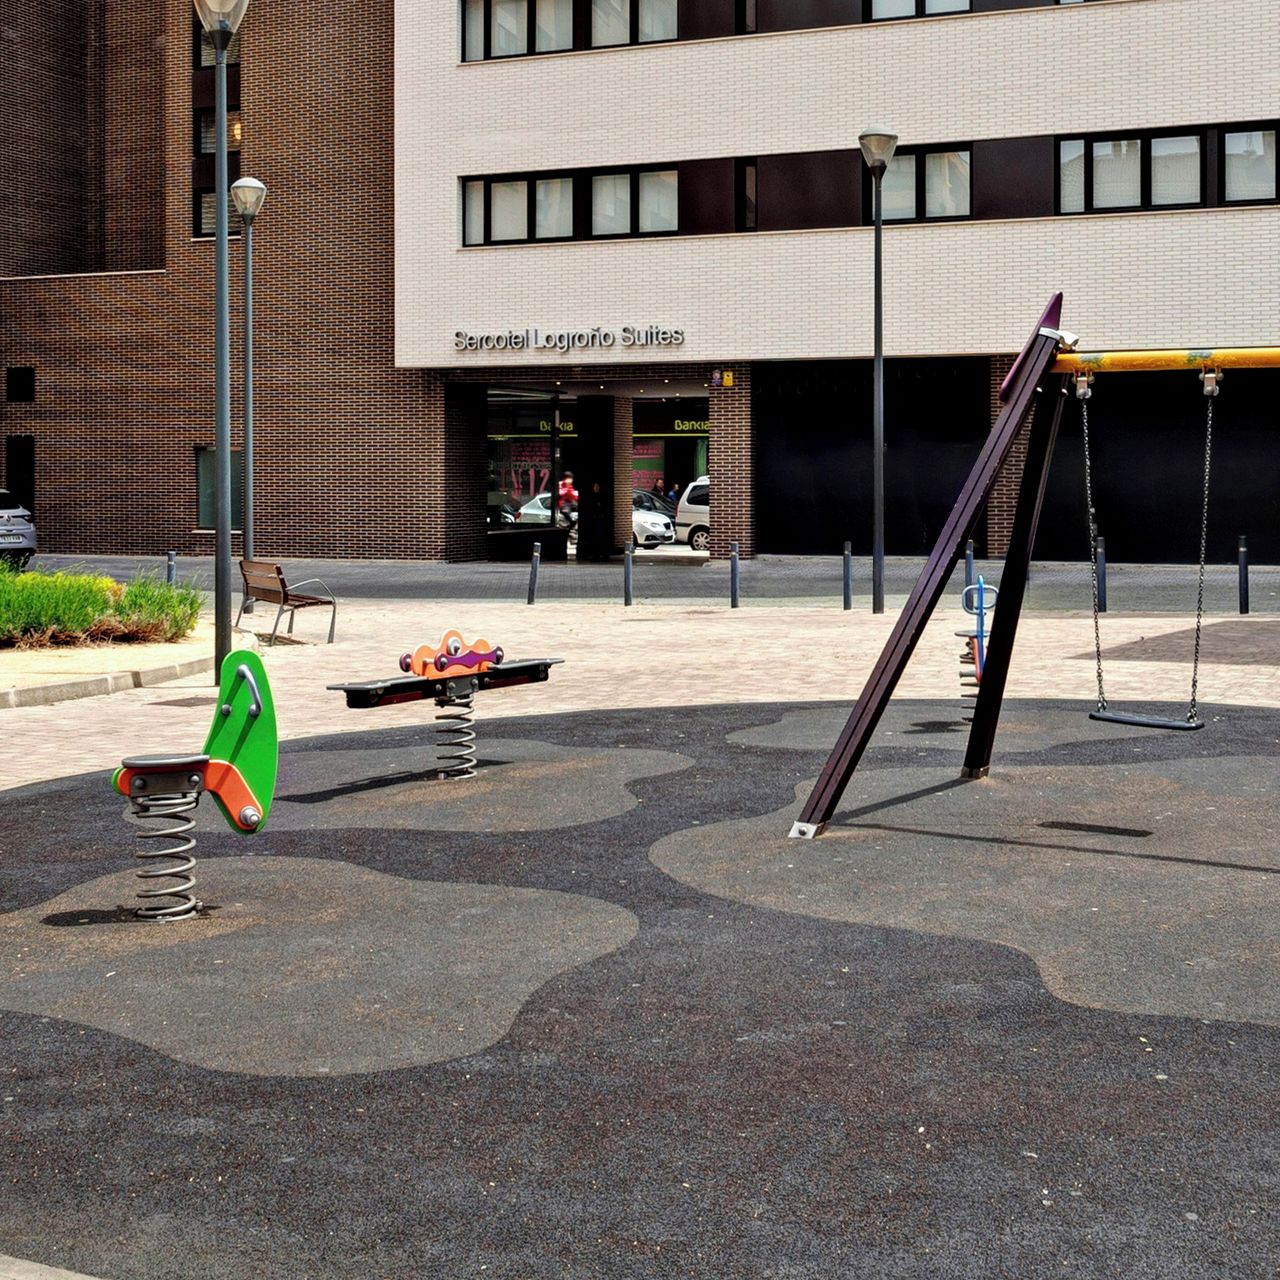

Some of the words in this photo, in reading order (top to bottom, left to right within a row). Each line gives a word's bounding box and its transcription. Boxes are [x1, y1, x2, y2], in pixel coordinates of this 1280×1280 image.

[454, 328, 529, 351] Sercotel
[533, 326, 615, 353] Logroño
[621, 325, 685, 346] Suites
[674, 420, 710, 431] Bankia
